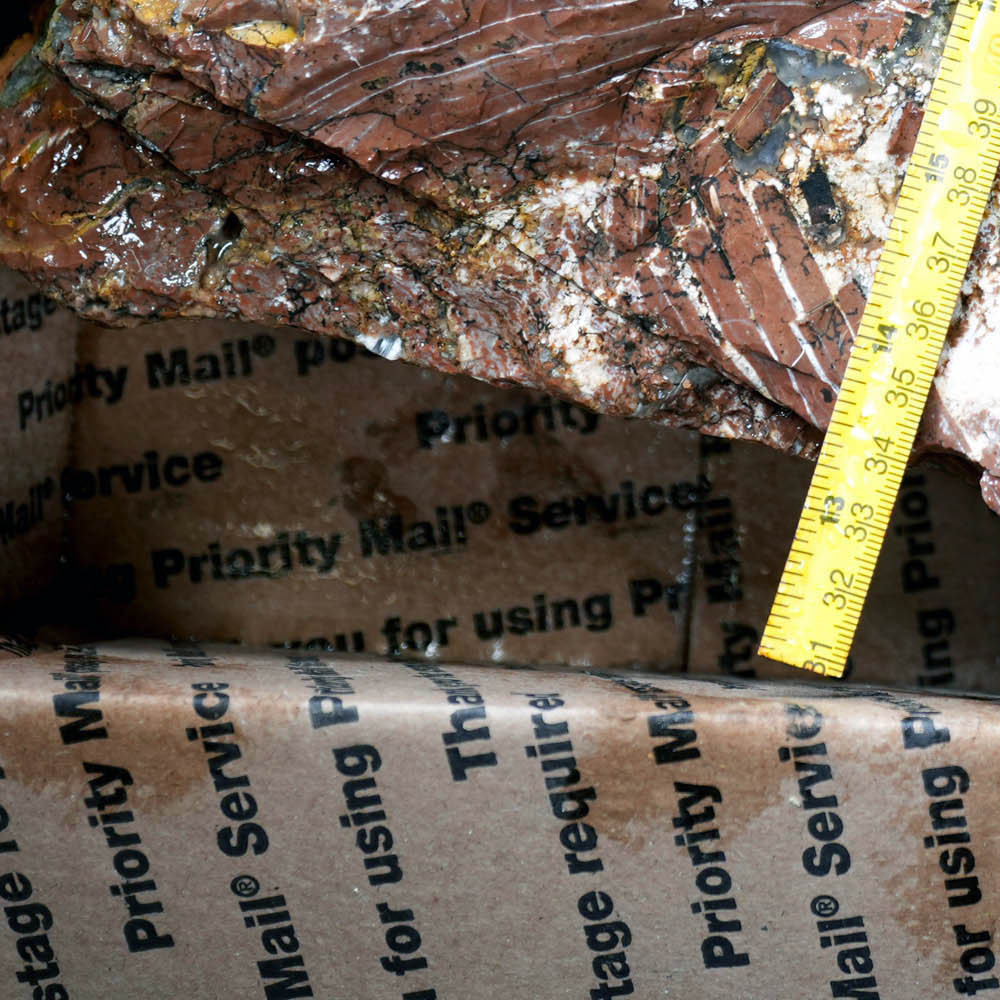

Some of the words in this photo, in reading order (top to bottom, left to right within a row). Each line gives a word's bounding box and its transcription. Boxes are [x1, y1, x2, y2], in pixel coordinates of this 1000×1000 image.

[967, 98, 999, 140] 39
[946, 165, 979, 208] 38
[926, 230, 958, 275] 37
[872, 323, 898, 356] 14
[905, 299, 937, 342] 36
[18, 362, 128, 430] Priority
[144, 332, 278, 391] Mail®
[884, 365, 916, 410] 35
[864, 434, 896, 477] 34
[820, 495, 846, 527] 13
[844, 501, 876, 543] 33
[150, 528, 344, 590] Priority
[357, 499, 491, 560] Mail®
[822, 568, 855, 611] 32
[380, 612, 458, 659] for
[472, 591, 613, 642] using
[185, 682, 270, 857] Service
[332, 743, 404, 886] using
[922, 765, 983, 908] using
[82, 761, 175, 953] Priority
[672, 781, 750, 969] Priority
[376, 902, 428, 976] for
[952, 924, 1000, 997] for
